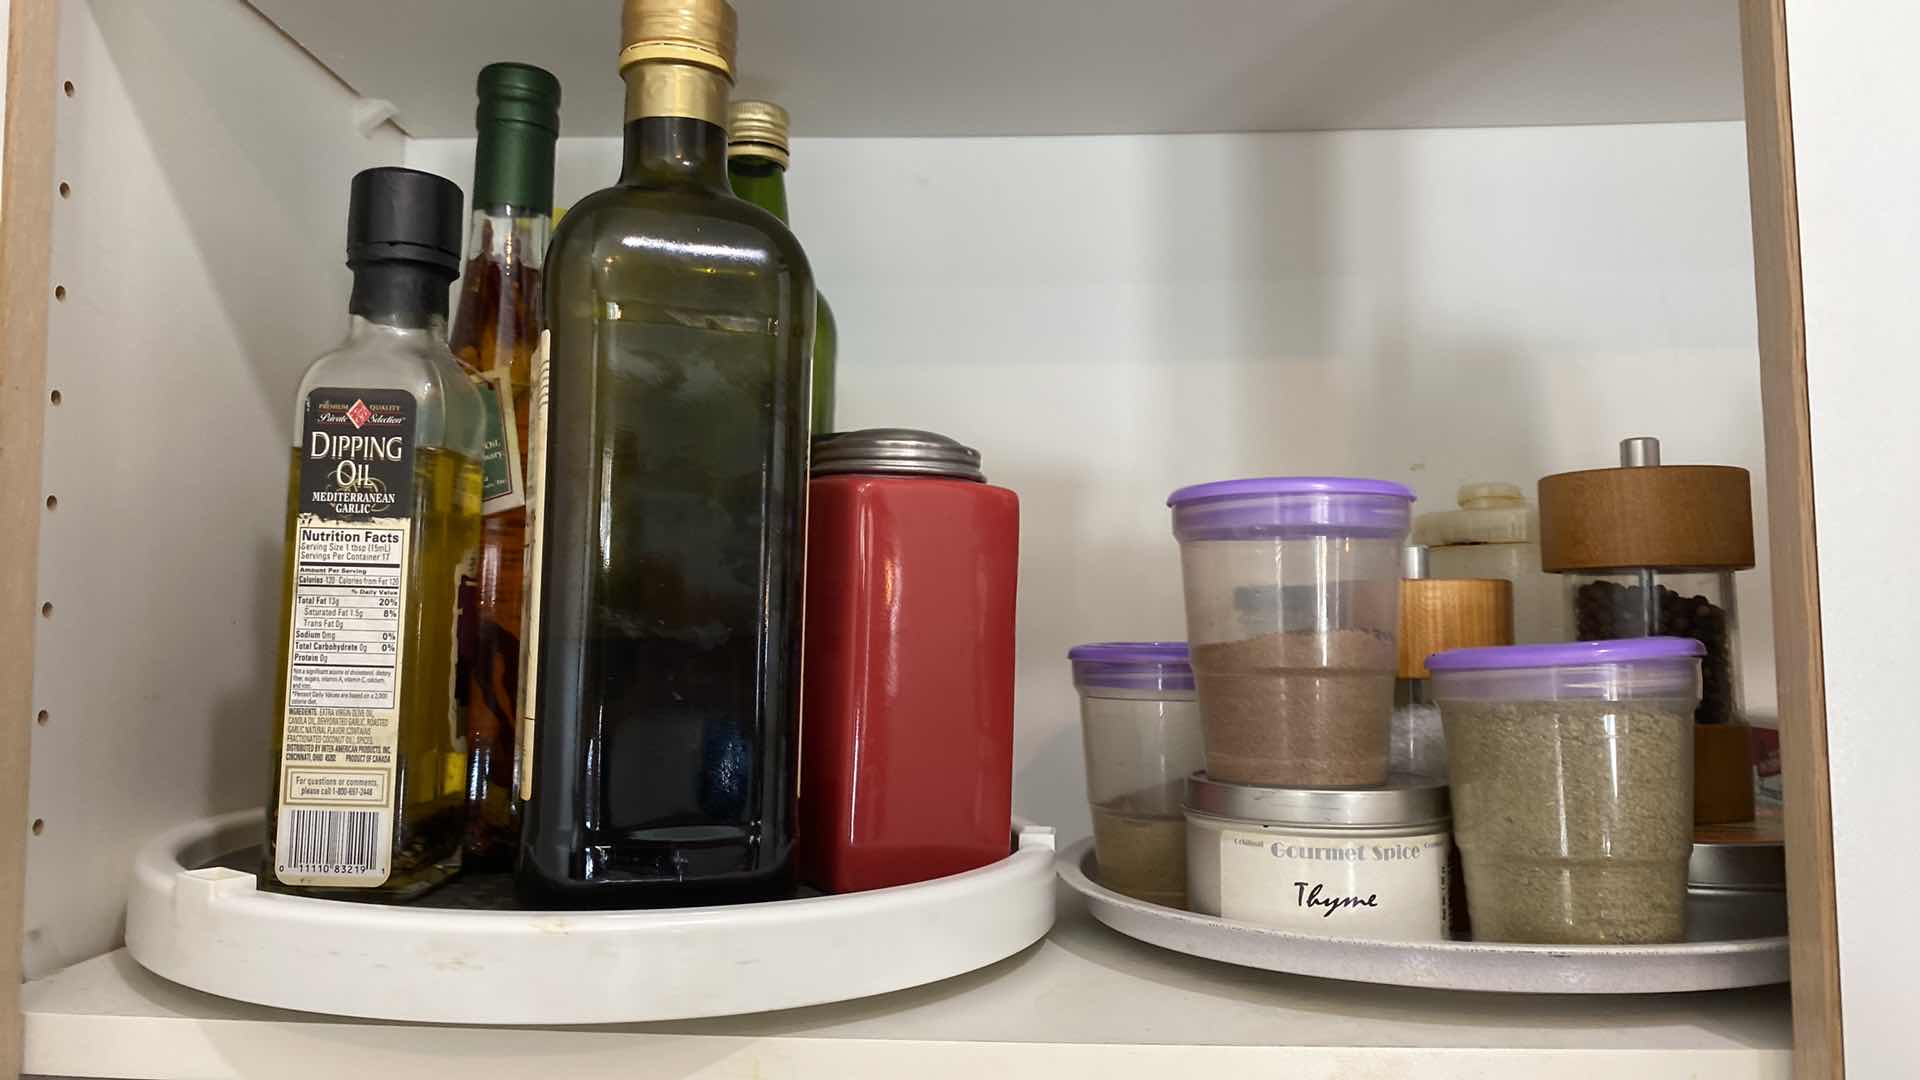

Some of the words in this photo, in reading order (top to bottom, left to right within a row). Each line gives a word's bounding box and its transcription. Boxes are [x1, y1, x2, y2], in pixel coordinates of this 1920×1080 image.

[318, 413, 348, 422] Private
[368, 413, 402, 424] Selection
[312, 492, 395, 503] MEDITERRANEAN
[336, 504, 371, 513] GARLIC
[302, 530, 360, 542] Nutrition
[365, 532, 399, 543] Facts
[301, 543, 327, 551] Serving
[301, 551, 330, 560] Servings
[304, 608, 336, 616] Saturated
[314, 642, 357, 652] Carbohydrate
[296, 776, 306, 784] For
[308, 777, 336, 785] questions
[301, 787, 320, 796] please
[1270, 841, 1367, 861] Gourmet
[1372, 842, 1420, 861] Spice
[334, 865, 366, 873] 83219
[1294, 882, 1378, 918] Thyme
